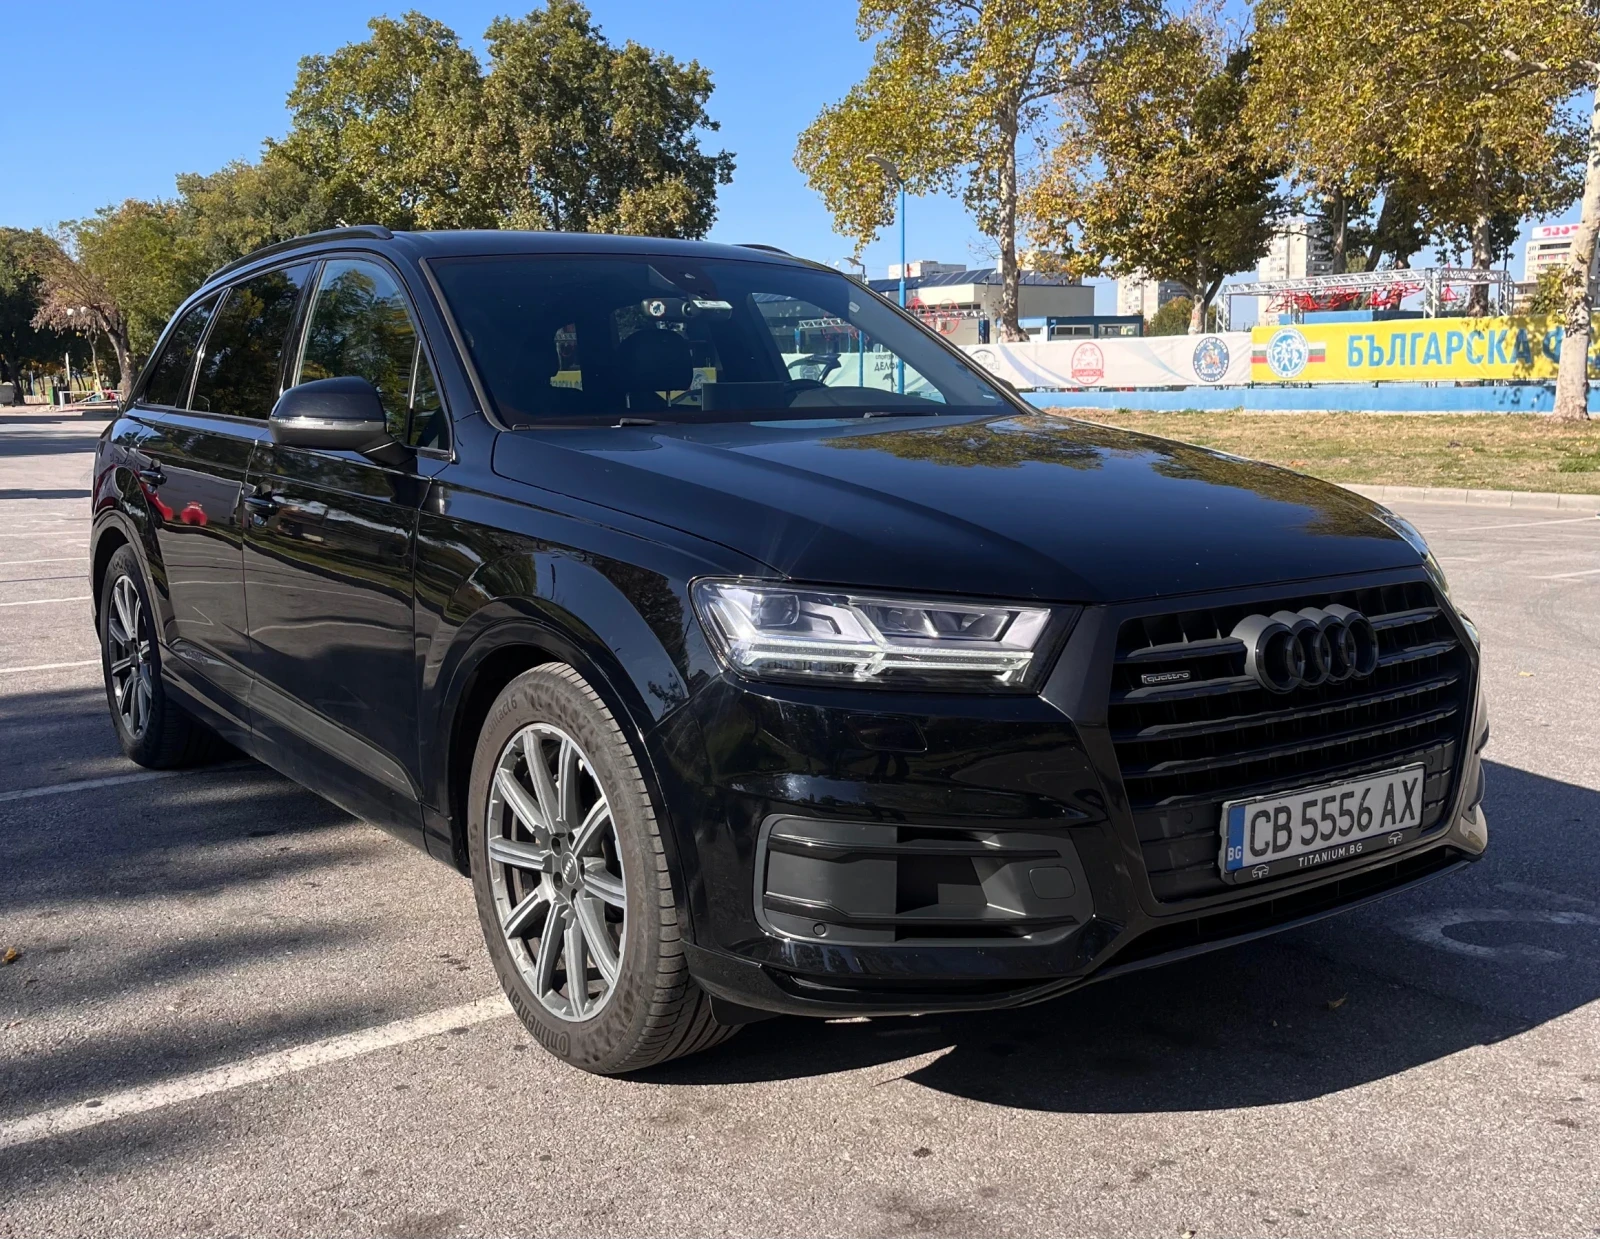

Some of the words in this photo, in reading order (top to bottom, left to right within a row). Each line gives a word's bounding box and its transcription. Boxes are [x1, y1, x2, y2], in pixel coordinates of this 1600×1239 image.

[1347, 327, 1532, 367] БЪЛГАРСКА
[1146, 672, 1190, 683] quattro
[1249, 805, 1293, 857] CB
[1300, 787, 1373, 846] 5556
[1379, 777, 1419, 828] AX
[1227, 845, 1242, 861] BG
[1298, 843, 1363, 867] TITANIUM.BG
